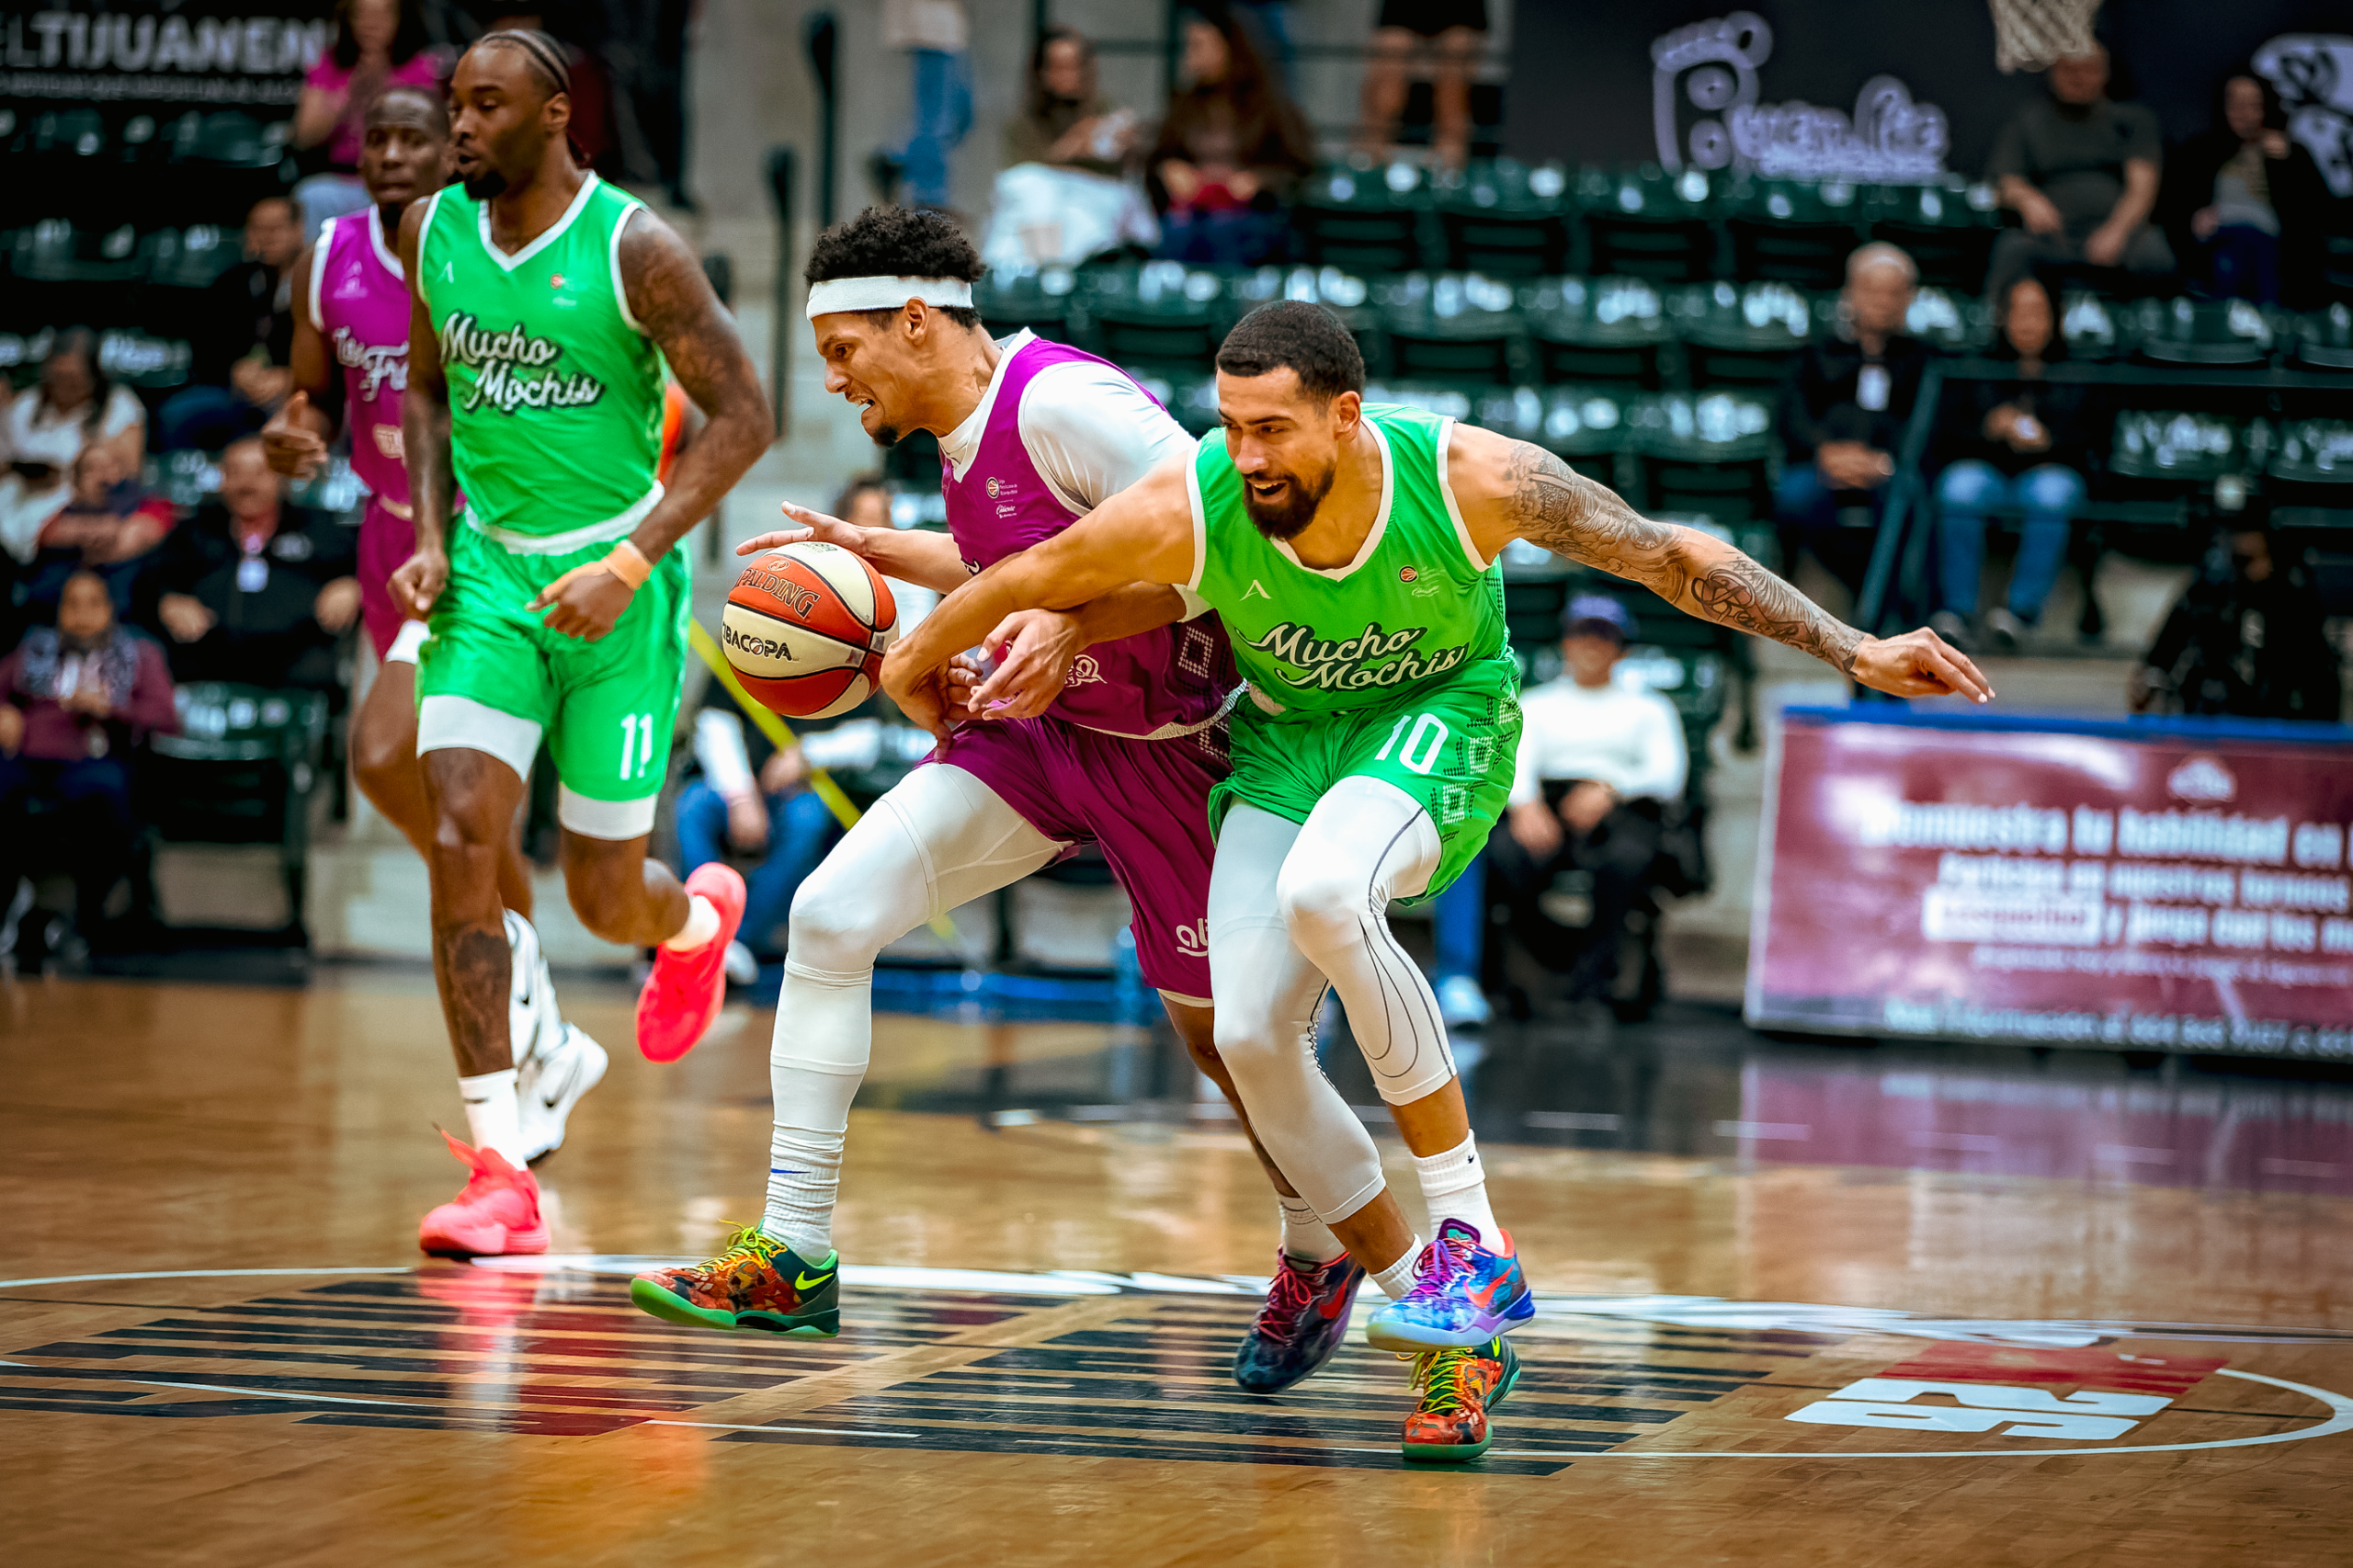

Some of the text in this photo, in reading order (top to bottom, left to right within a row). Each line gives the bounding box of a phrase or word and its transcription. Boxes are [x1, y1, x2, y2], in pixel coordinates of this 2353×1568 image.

[438, 309, 563, 368] Mucho
[463, 358, 606, 415] Mochis
[735, 568, 821, 619] PALDING
[722, 621, 792, 662] BACOPA
[1234, 621, 1428, 668] Mucho
[1274, 642, 1470, 690] Mochis
[619, 711, 654, 781] 11
[1374, 712, 1449, 775] 10
